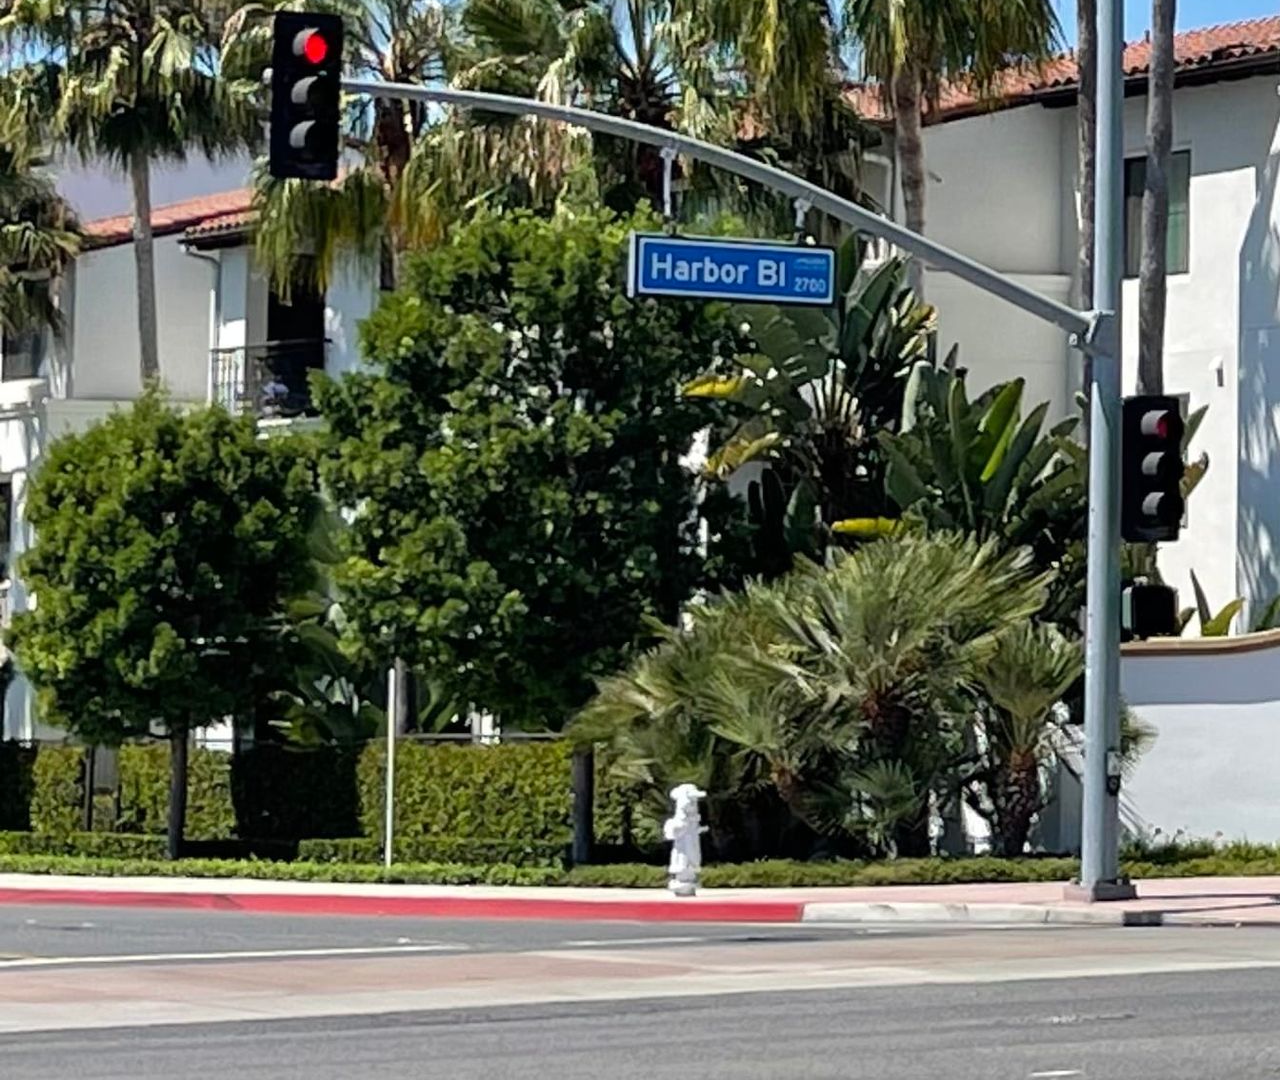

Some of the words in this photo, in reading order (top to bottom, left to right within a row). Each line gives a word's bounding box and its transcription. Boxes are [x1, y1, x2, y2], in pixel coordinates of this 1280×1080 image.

[651, 252, 749, 284] Harbor
[758, 259, 786, 287] Bl
[794, 277, 827, 293] 2700
